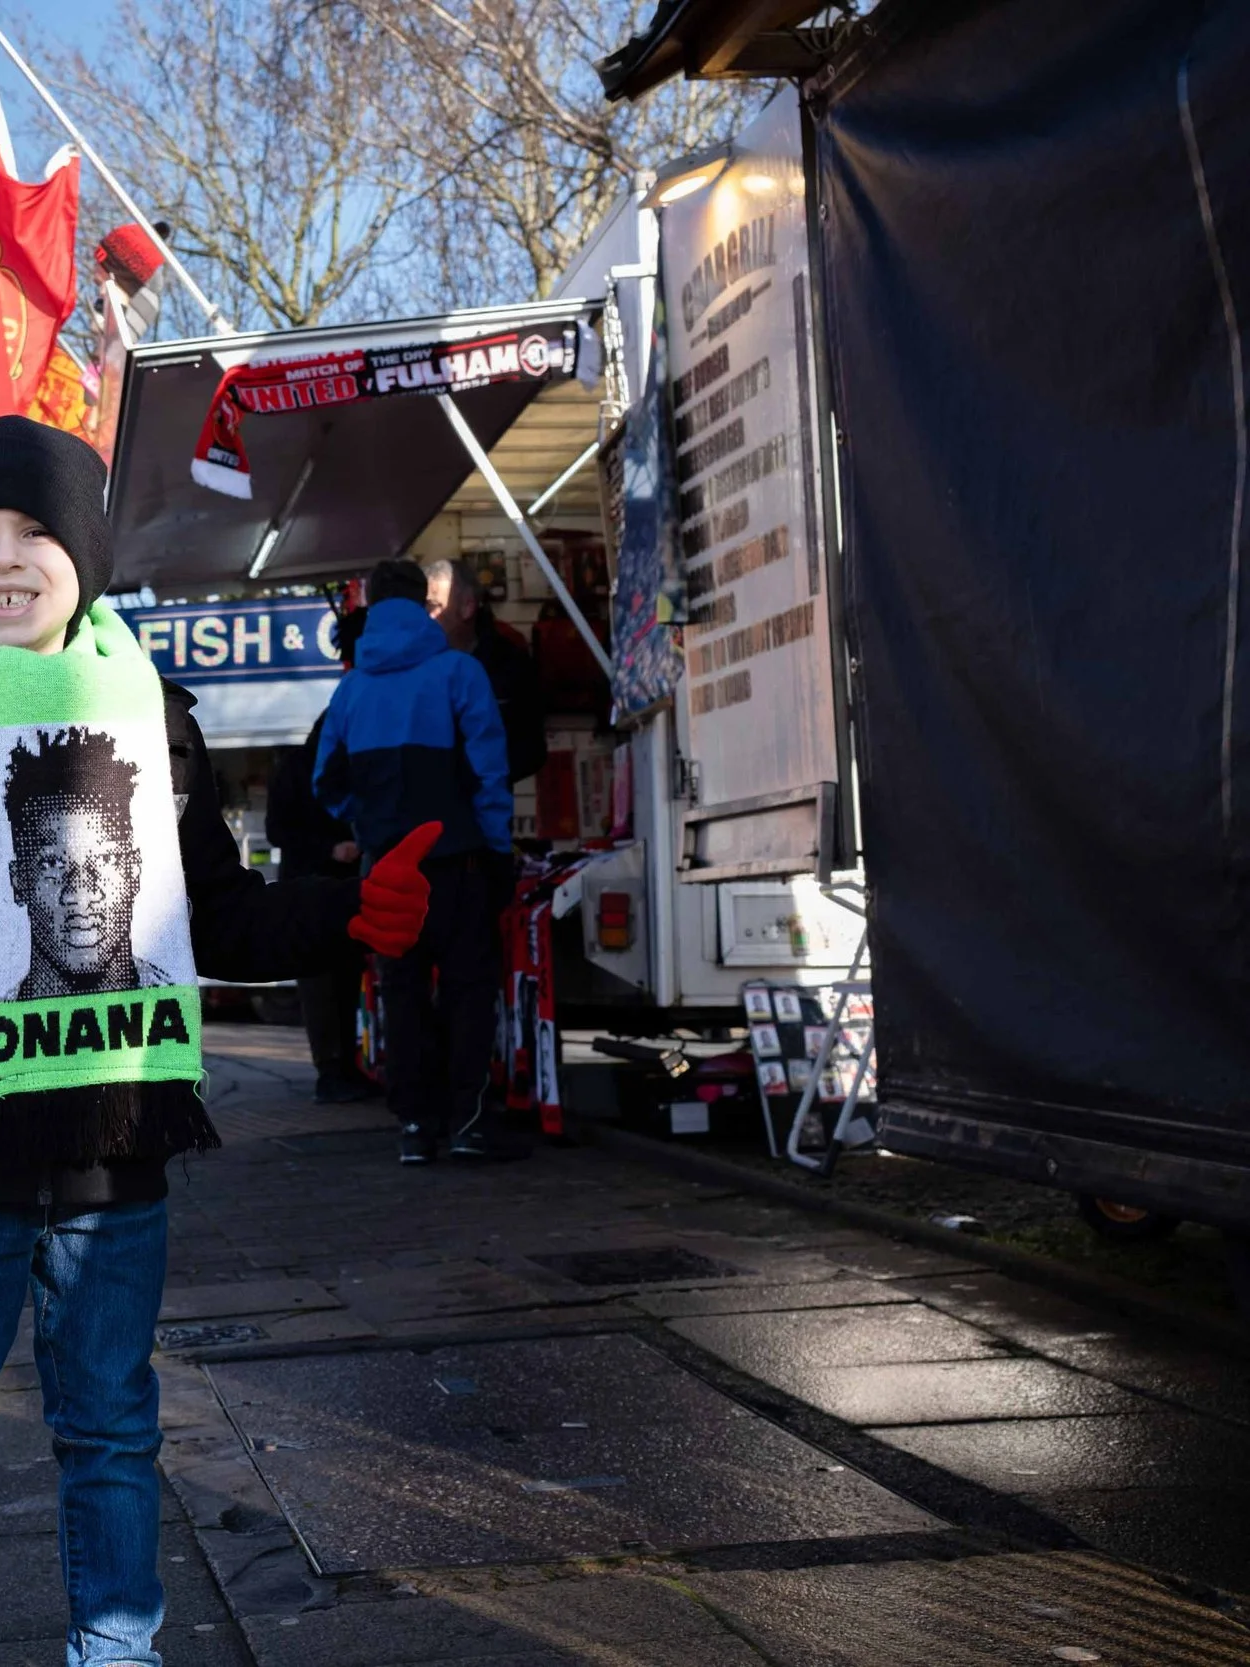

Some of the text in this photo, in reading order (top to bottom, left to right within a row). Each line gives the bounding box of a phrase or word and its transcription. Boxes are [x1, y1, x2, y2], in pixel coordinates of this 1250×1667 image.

[237, 375, 360, 413] UNITED
[375, 343, 521, 393] FULHAM
[285, 363, 341, 381] MATCH
[343, 358, 365, 373] OF
[370, 353, 401, 368] THE
[402, 347, 432, 362] DAY
[138, 614, 272, 668] FISH
[282, 623, 306, 651] &
